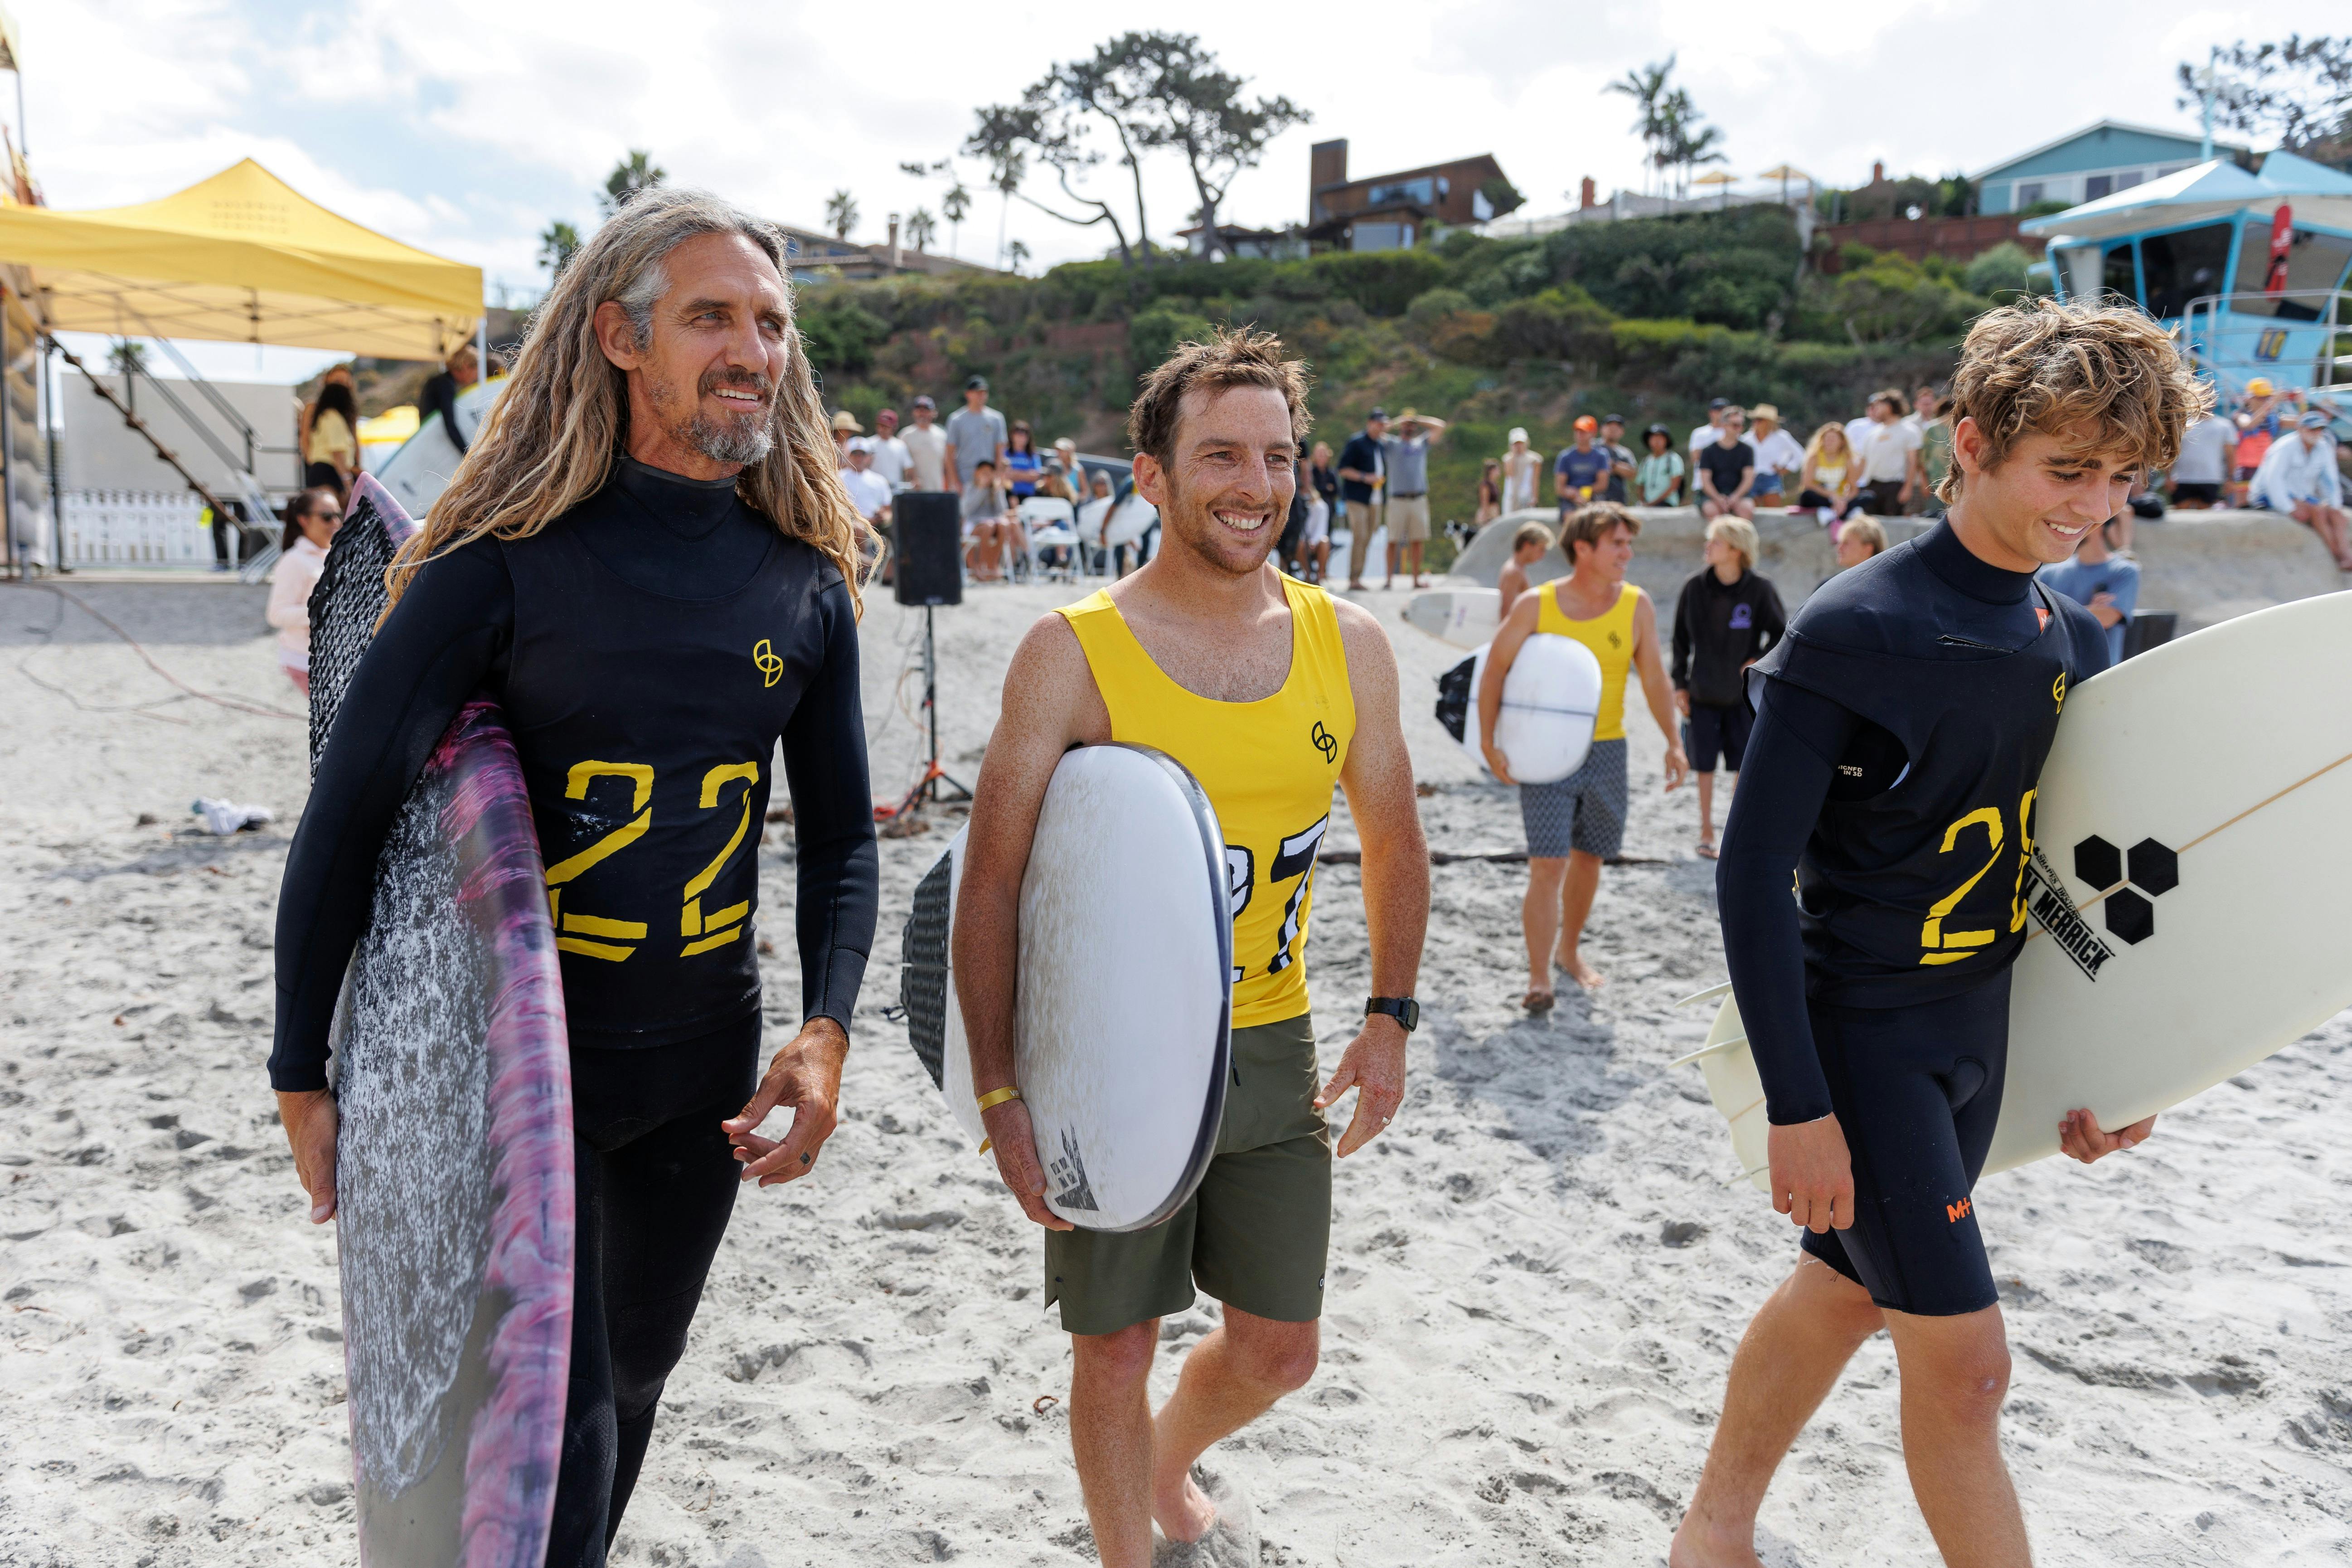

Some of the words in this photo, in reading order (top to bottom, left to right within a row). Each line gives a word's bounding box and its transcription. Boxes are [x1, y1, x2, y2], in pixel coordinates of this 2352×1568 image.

[545, 760, 759, 962] 22
[2037, 854, 2059, 884] SHAPES
[2056, 887, 2080, 922] DESIGNS
[2033, 889, 2110, 976] MERRICK
